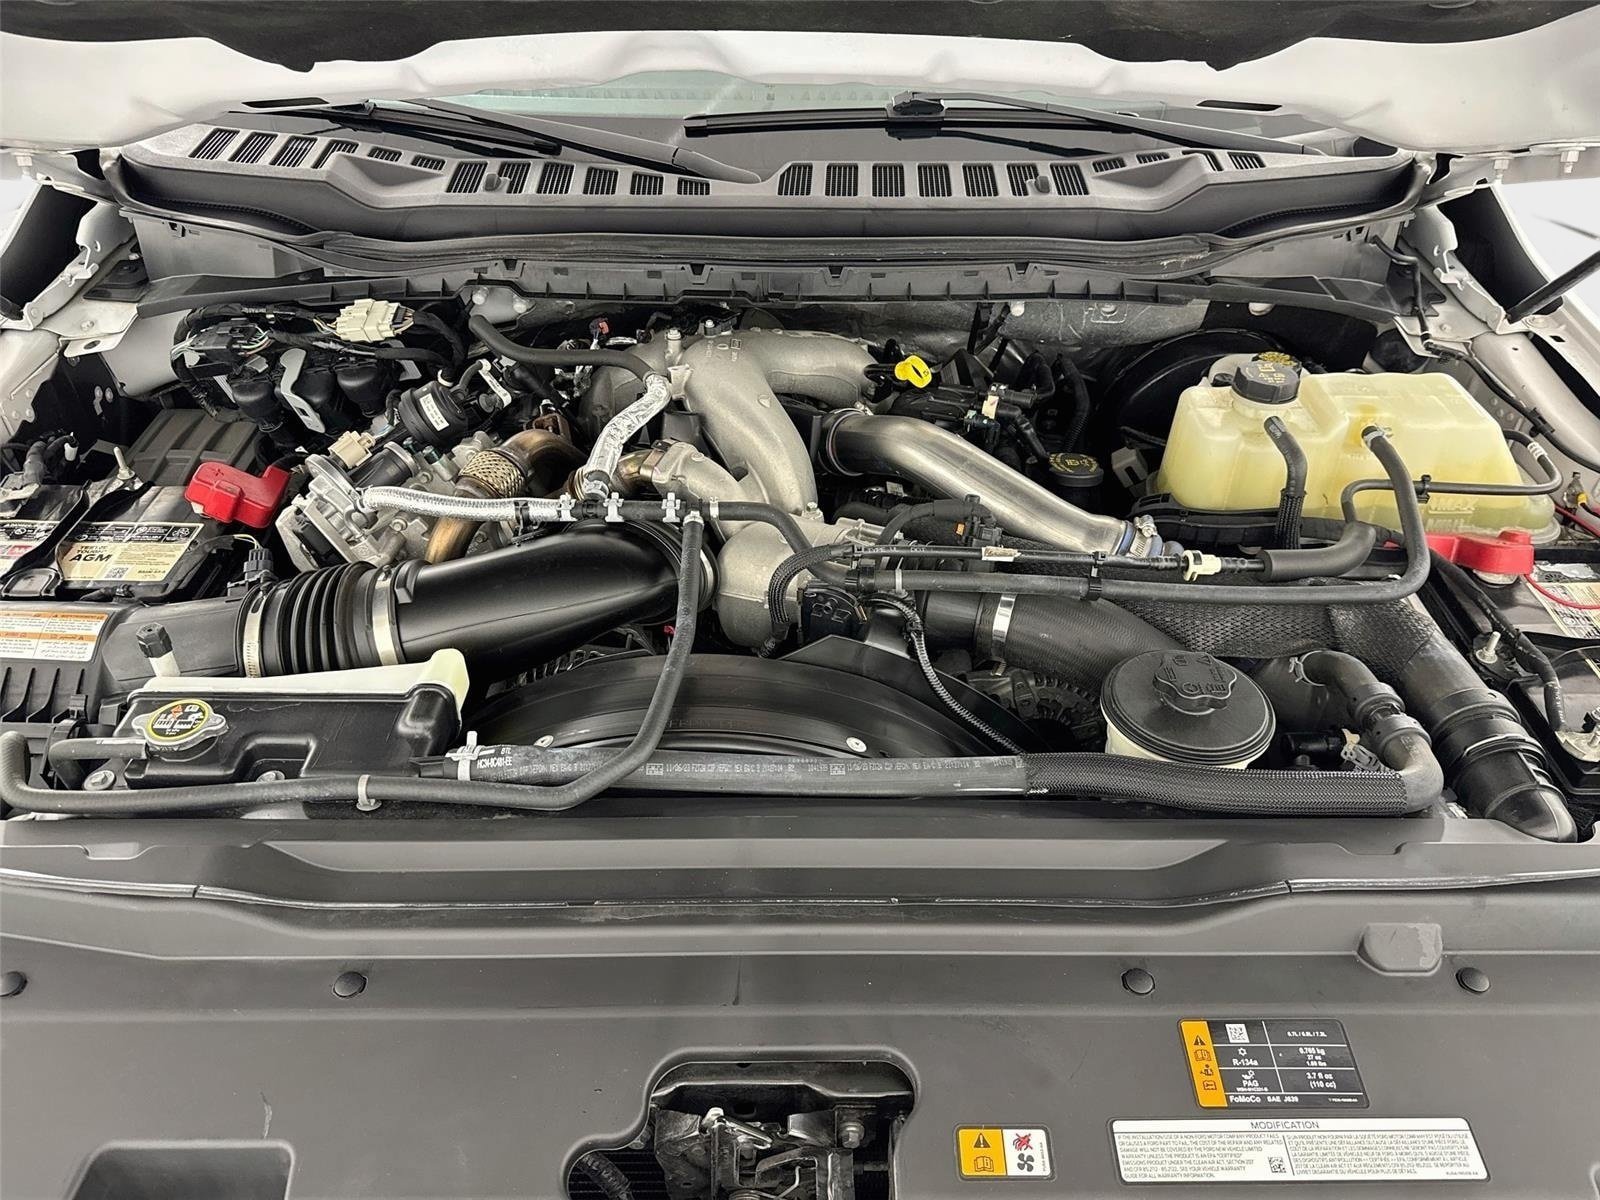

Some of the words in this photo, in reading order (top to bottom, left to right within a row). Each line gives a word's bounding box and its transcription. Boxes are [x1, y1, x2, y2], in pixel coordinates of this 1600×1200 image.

[69, 554, 112, 562] AGM
[1325, 1081, 1336, 1089] cc)
[1250, 1121, 1320, 1130] MODIFICATION
